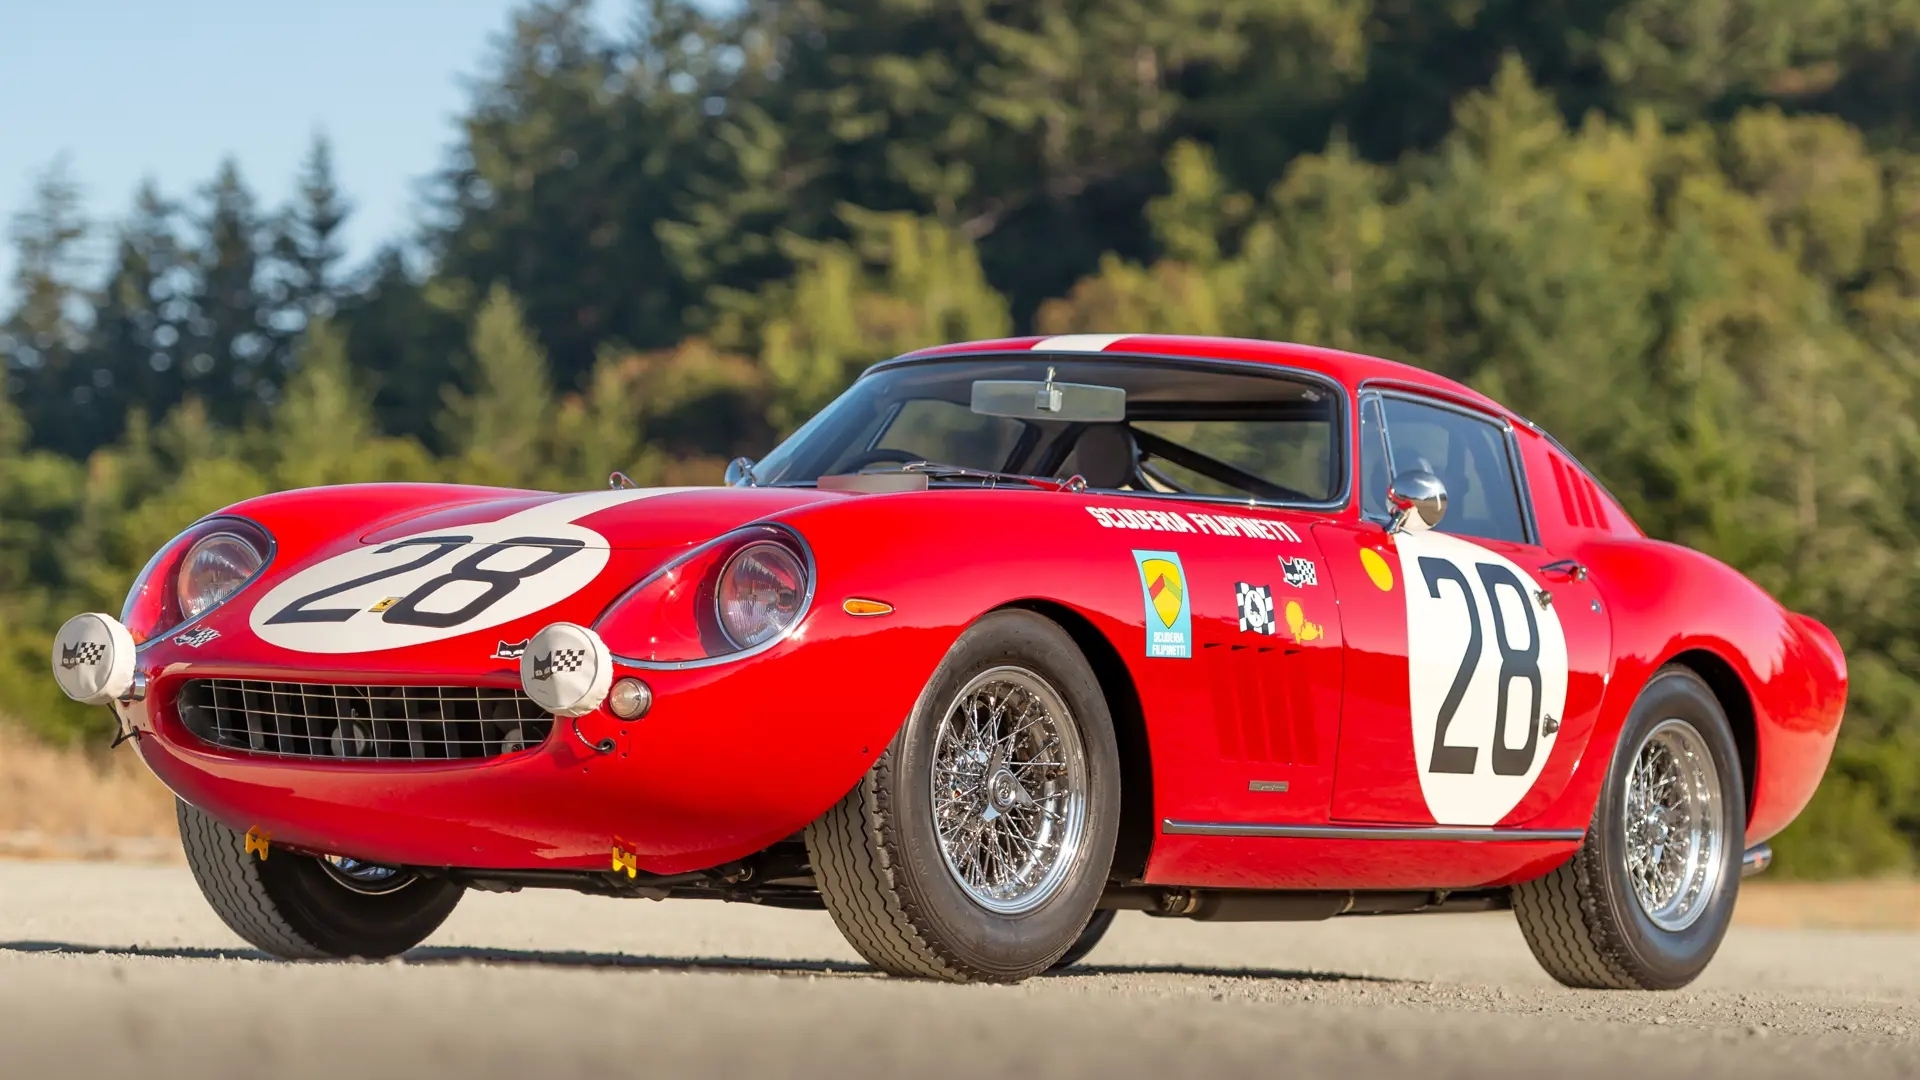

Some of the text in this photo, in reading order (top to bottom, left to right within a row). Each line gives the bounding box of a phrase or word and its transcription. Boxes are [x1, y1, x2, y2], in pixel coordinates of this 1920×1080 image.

[1084, 506, 1303, 543] SCUDERIA FILIPINETTI
[262, 535, 586, 629] 28
[1152, 644, 1187, 657] FILIPINETTI
[1153, 631, 1185, 644] SCUDERIA
[1417, 555, 1542, 777] 28
